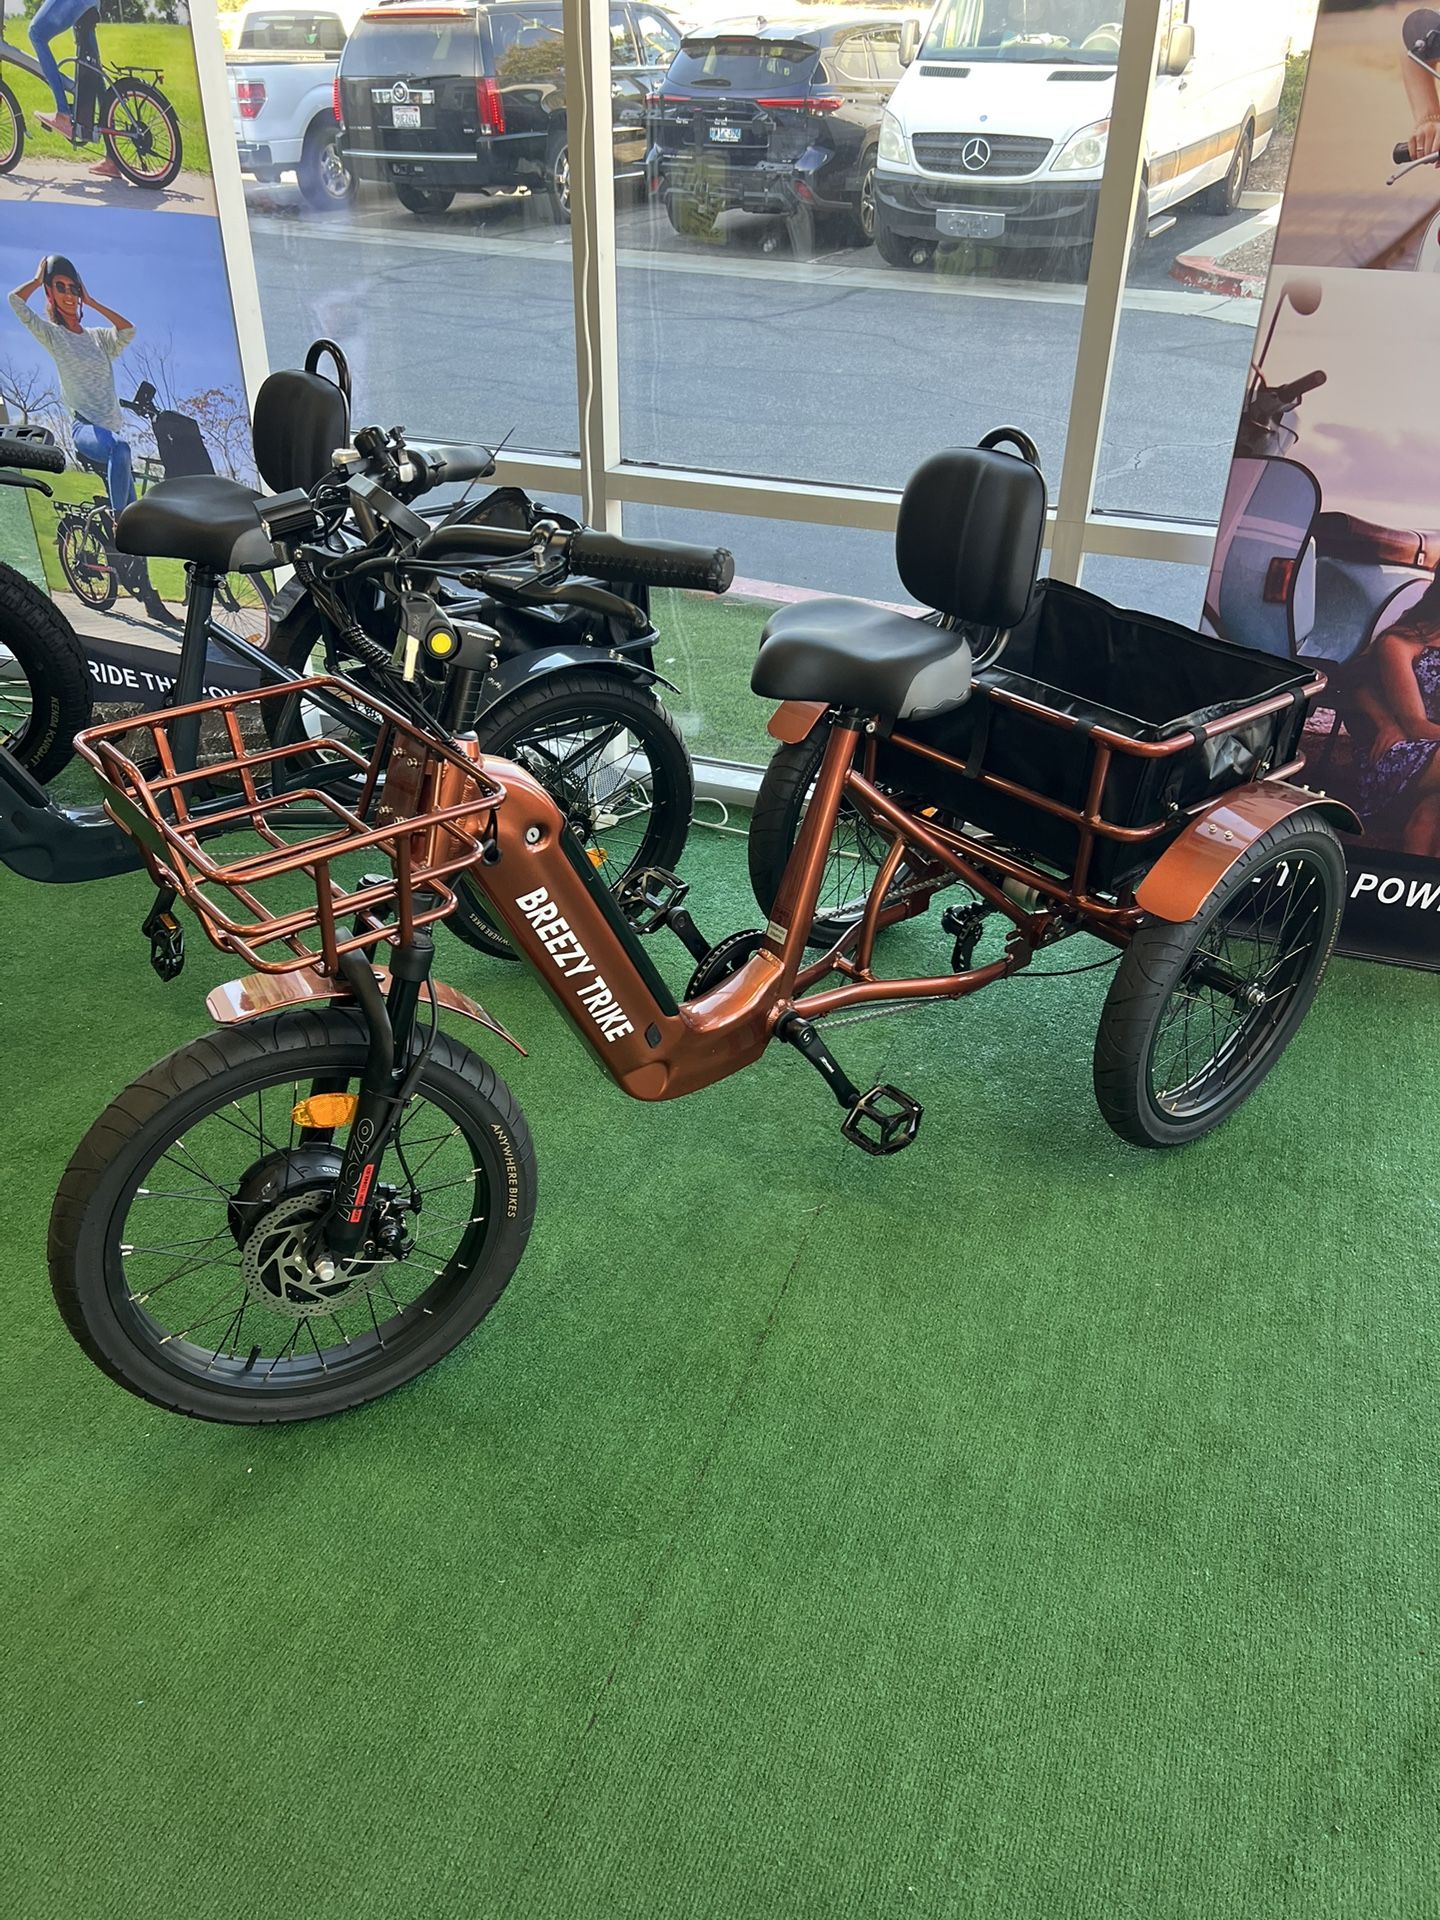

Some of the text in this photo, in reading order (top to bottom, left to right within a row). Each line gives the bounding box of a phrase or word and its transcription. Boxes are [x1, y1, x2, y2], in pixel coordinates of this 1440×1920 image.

[87, 660, 140, 689] RIDE
[140, 671, 177, 693] TH
[1350, 872, 1440, 912] POW
[515, 886, 635, 1043] BREEZY TRIKE
[490, 1123, 518, 1218] ANYWHERE BIKES
